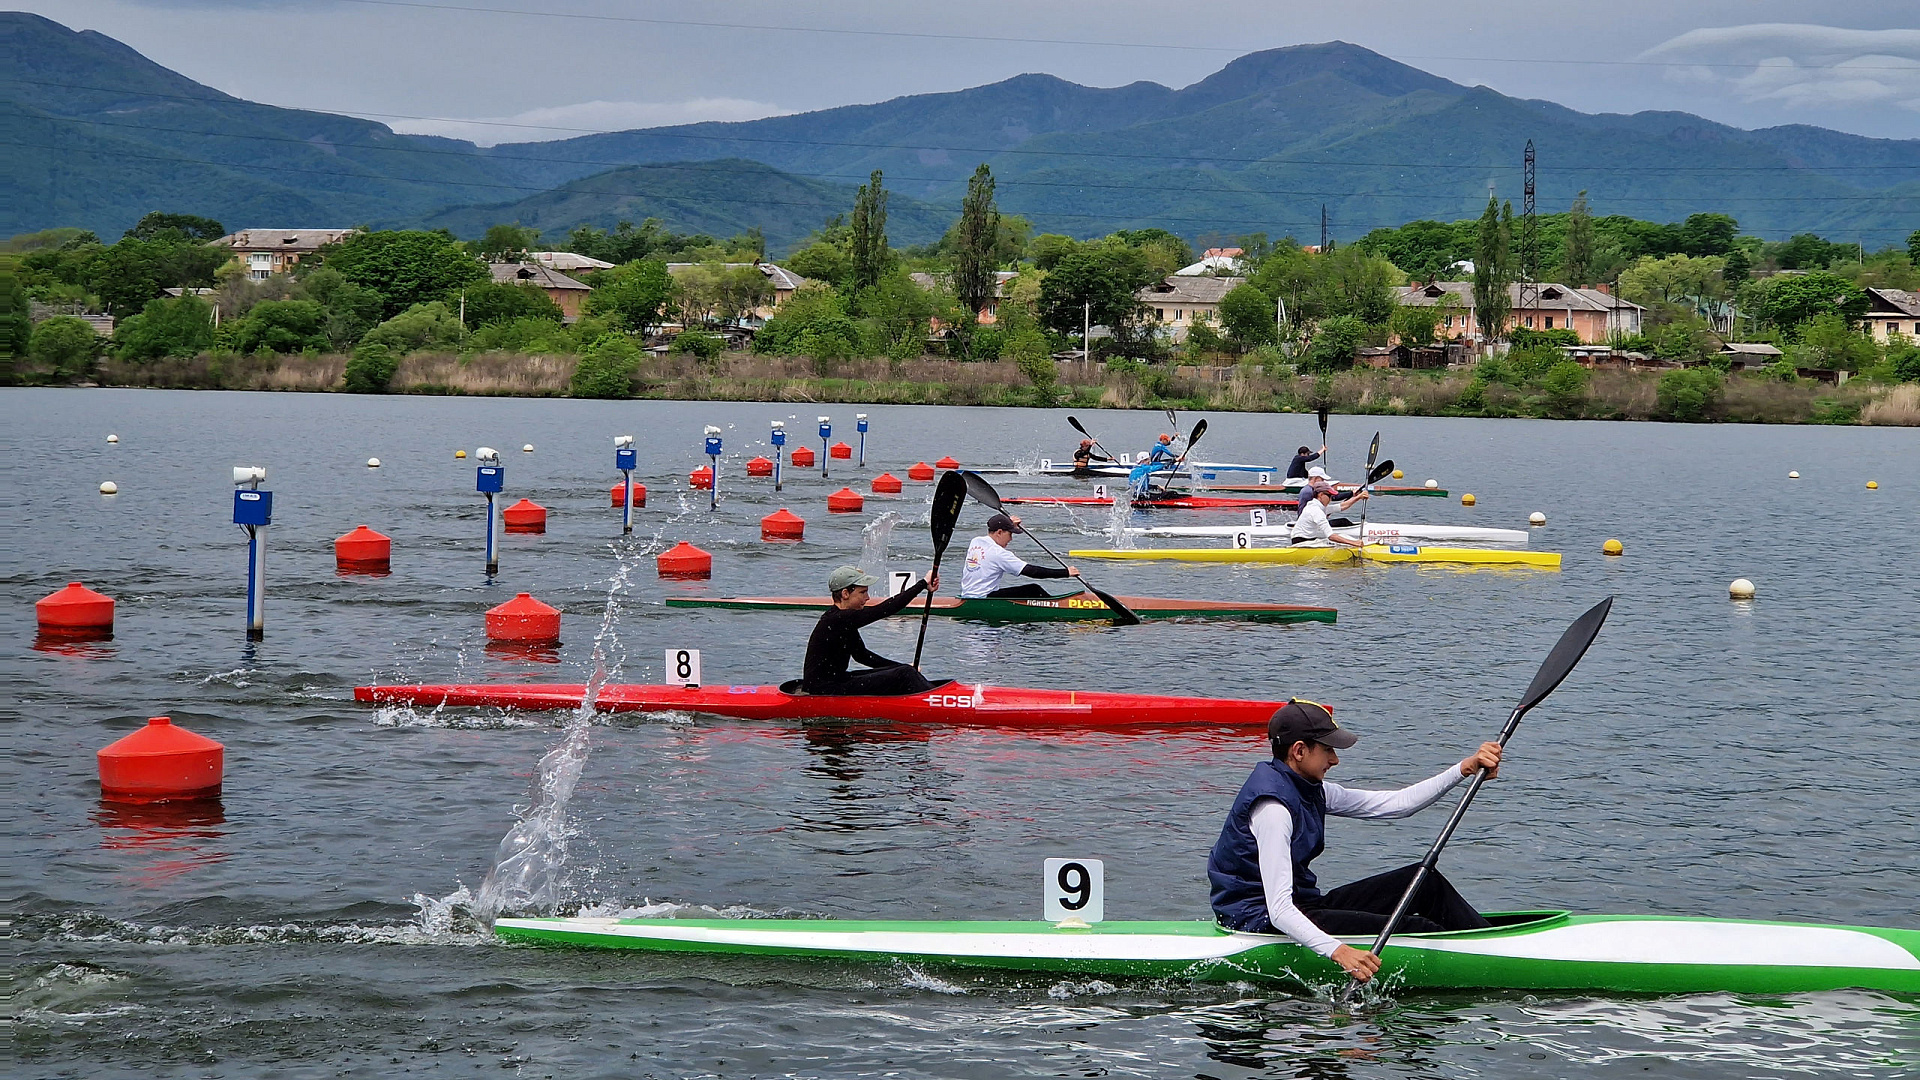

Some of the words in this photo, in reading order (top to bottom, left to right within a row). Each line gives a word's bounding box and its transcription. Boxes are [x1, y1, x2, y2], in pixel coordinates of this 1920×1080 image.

[1261, 474, 1268, 483] 3
[1096, 486, 1104, 495] 4
[1253, 511, 1263, 524] 5
[1237, 532, 1247, 547] 6
[896, 573, 911, 593] 7
[676, 650, 692, 679] 8
[1057, 862, 1092, 911] 9
